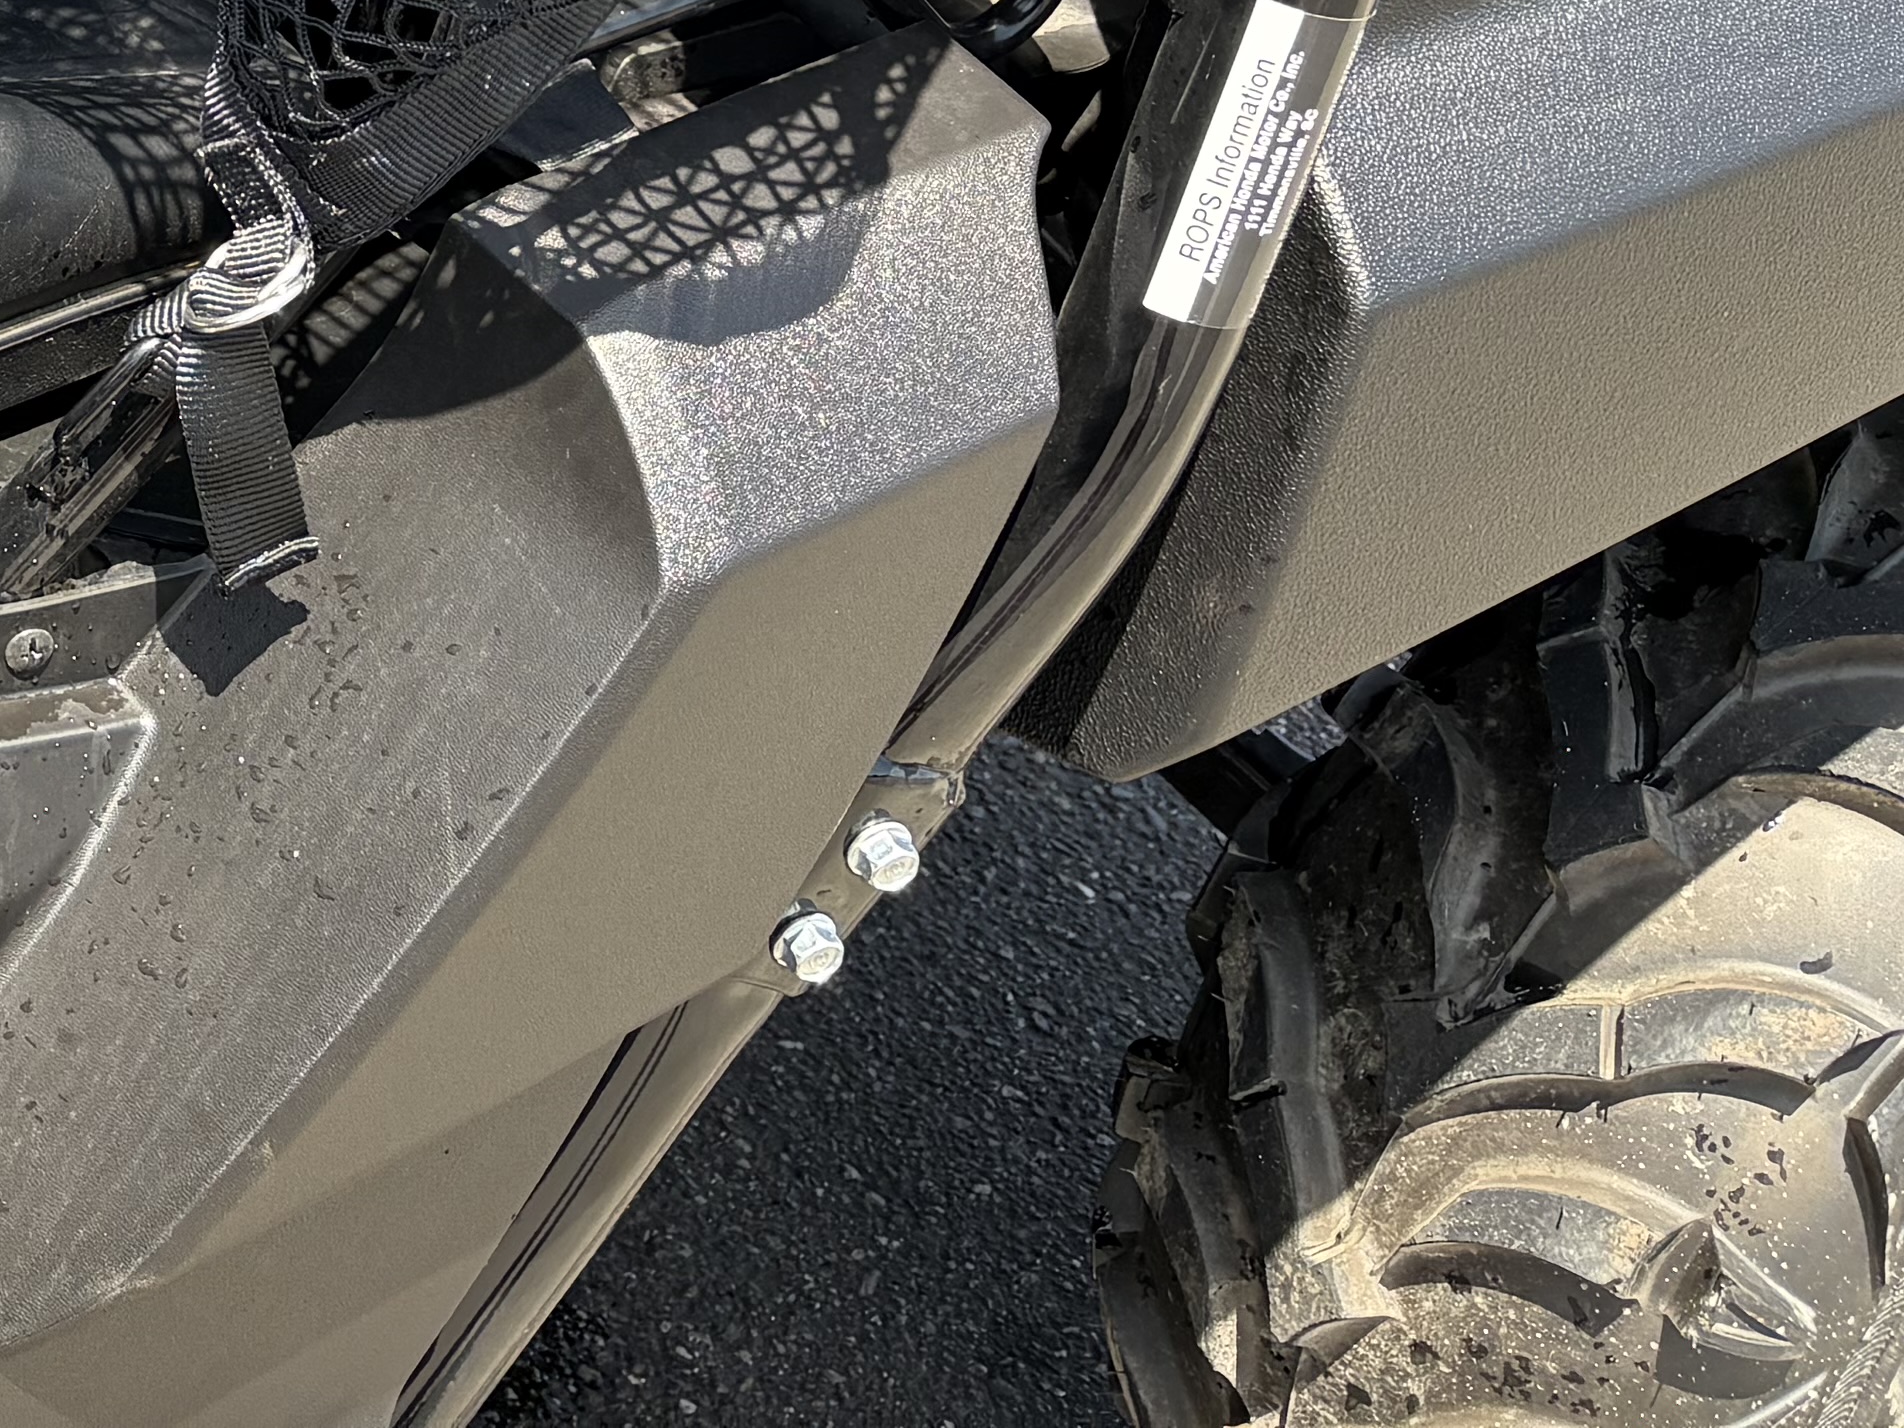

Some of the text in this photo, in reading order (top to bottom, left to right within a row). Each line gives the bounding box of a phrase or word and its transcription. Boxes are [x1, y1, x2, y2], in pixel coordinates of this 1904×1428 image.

[1179, 58, 1276, 262] ROPS Information
[1203, 212, 1243, 285] American
[1231, 161, 1262, 211] Honda
[1250, 119, 1280, 159] Motor
[1281, 50, 1306, 79] Inc.
[1244, 109, 1303, 231] 1111 Honda Way
[1301, 108, 1319, 131] SC
